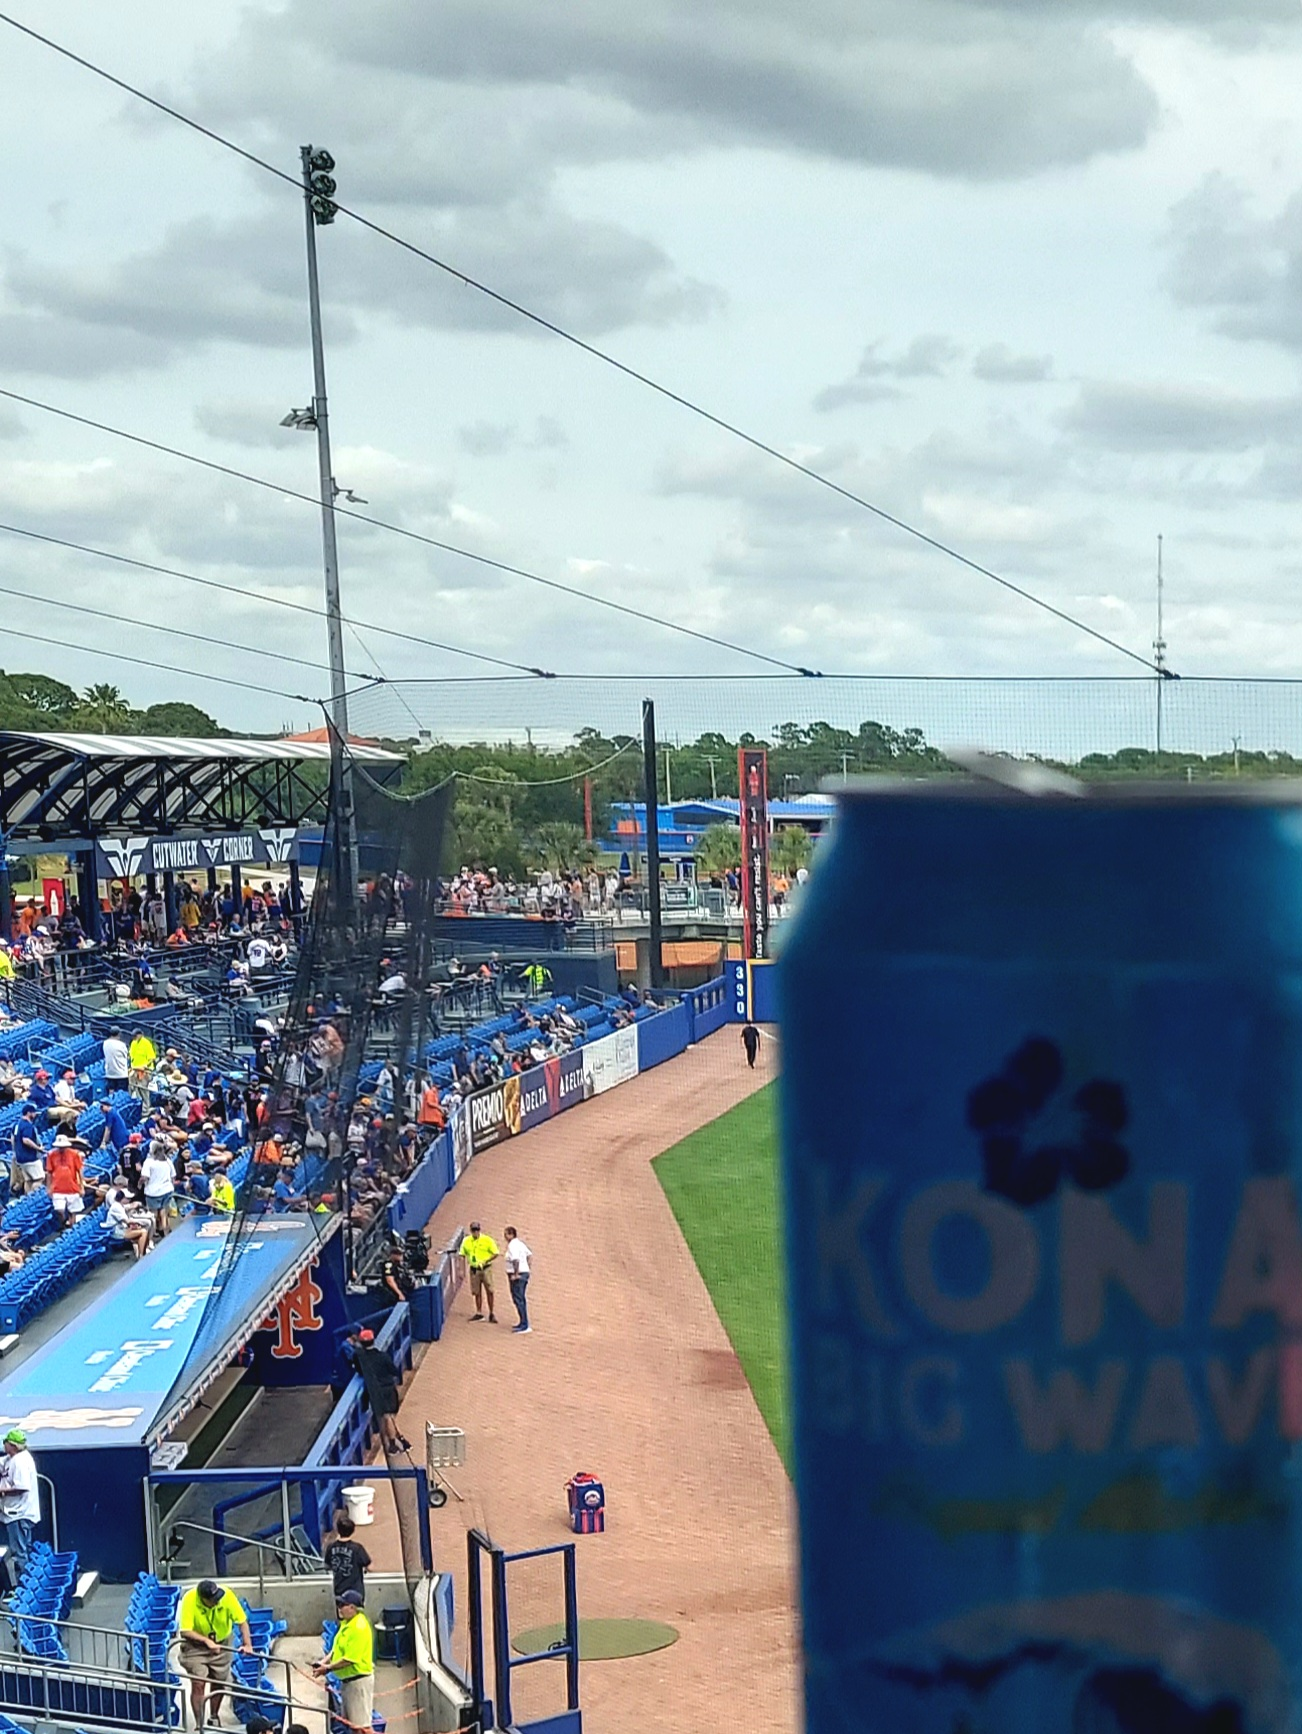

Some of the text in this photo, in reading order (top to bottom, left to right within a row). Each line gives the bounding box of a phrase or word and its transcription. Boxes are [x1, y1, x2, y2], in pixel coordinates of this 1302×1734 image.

[152, 840, 199, 869] CUTWATER
[223, 836, 254, 862] CORNER
[753, 887, 762, 911] can't
[755, 913, 764, 932] you
[755, 933, 763, 959] Taste
[471, 1089, 503, 1133] PREMIO
